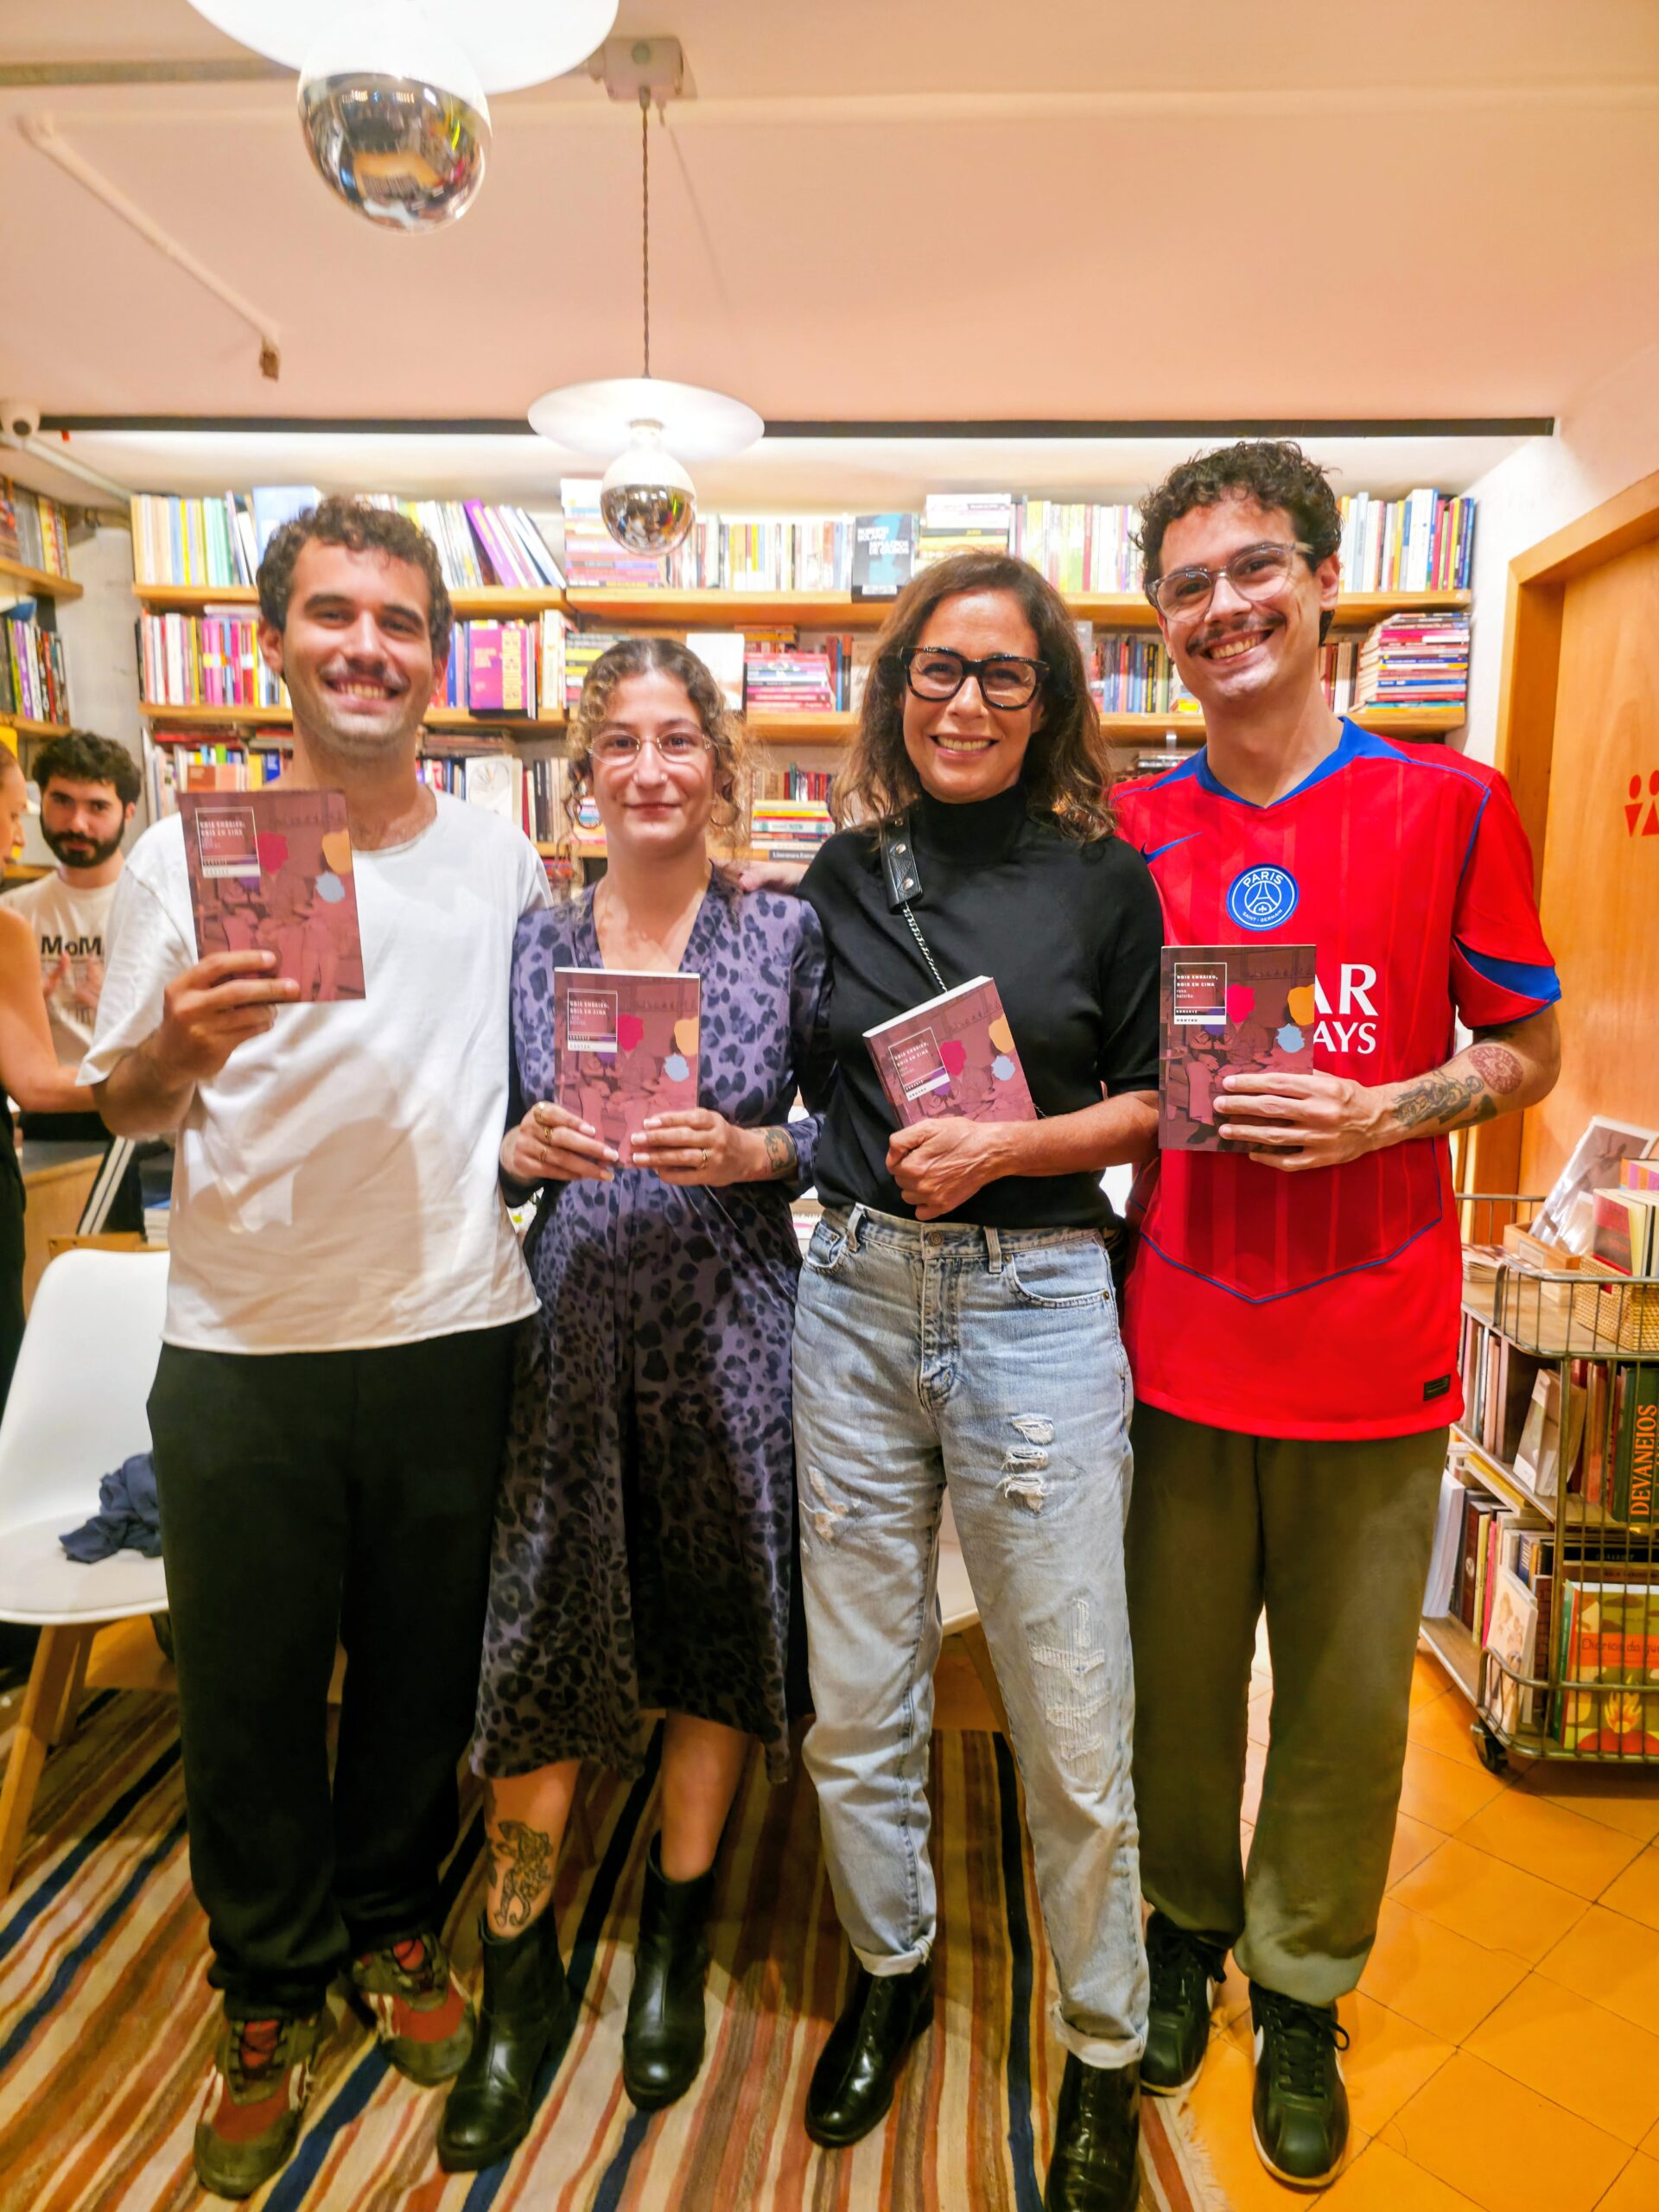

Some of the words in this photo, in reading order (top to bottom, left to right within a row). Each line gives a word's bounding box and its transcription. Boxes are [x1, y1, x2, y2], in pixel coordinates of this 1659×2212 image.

[1243, 871, 1284, 887] PARIS
[1313, 1020, 1377, 1054] AYS
[1630, 1404, 1658, 1516] DEVANEIOS
